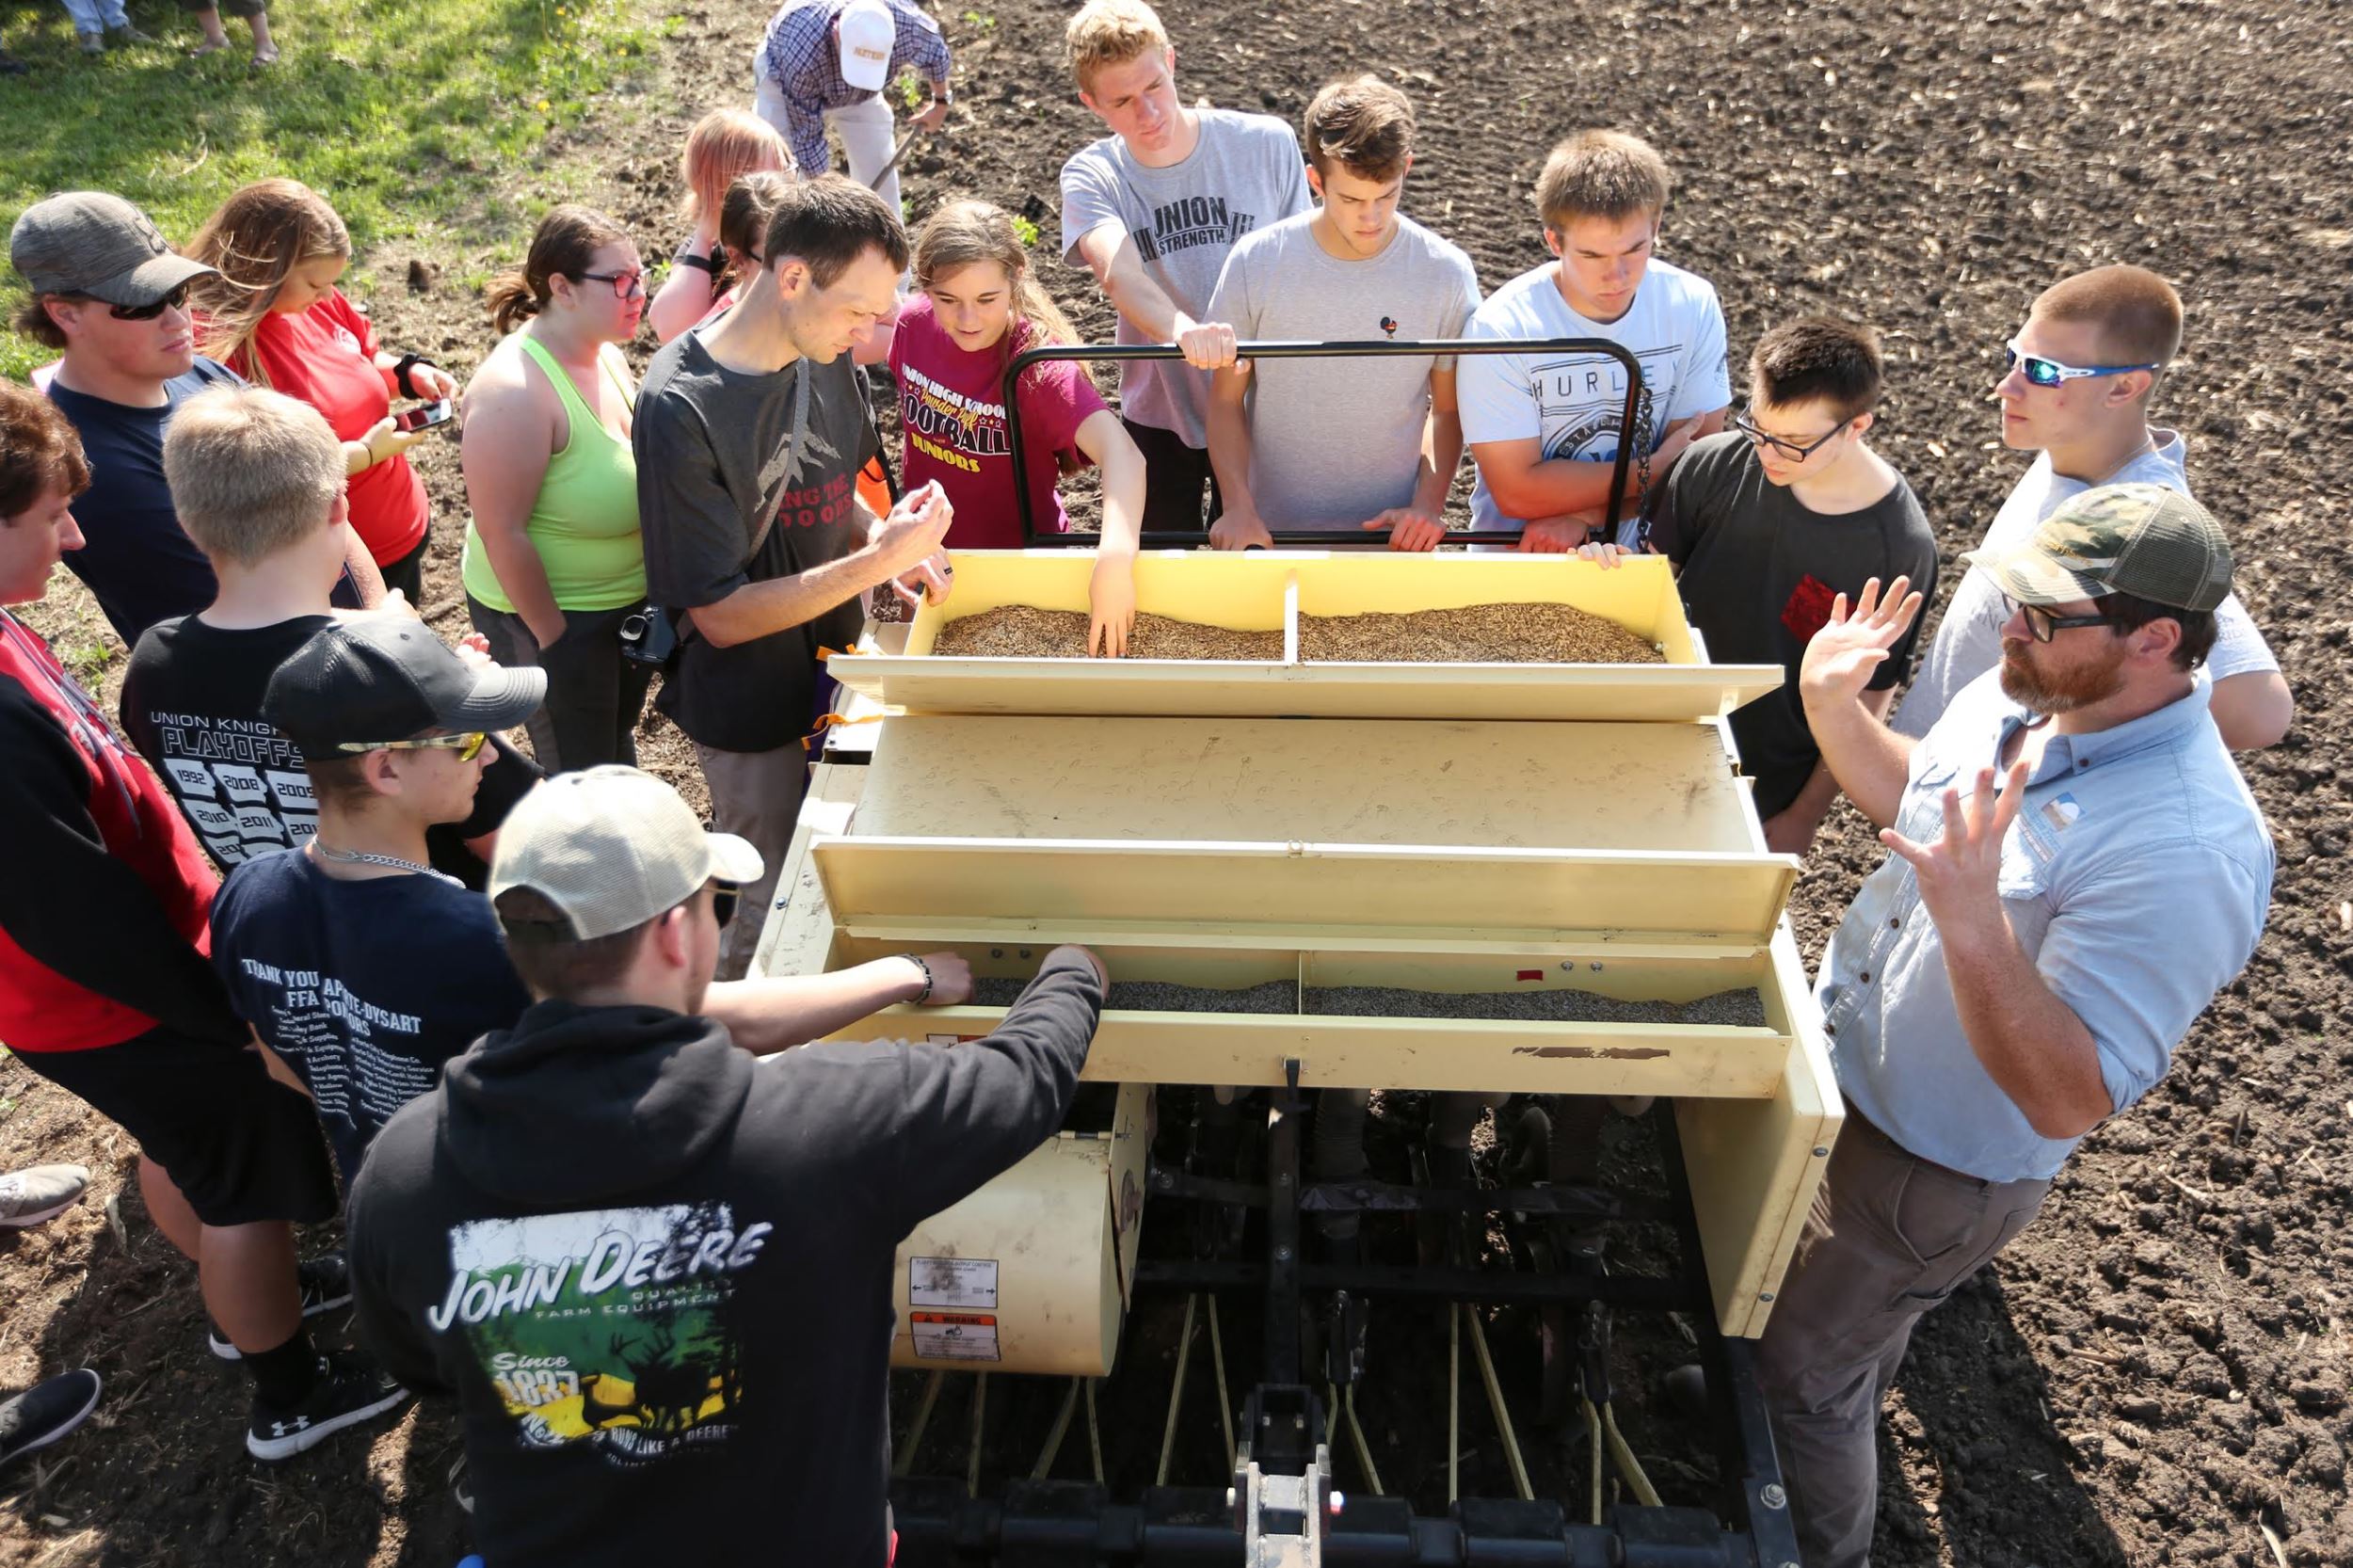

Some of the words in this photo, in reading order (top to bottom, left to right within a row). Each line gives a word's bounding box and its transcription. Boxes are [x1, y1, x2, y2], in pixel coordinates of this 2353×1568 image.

[1158, 229, 1225, 256] STRENGTH
[929, 380, 964, 408] HIGH
[1532, 361, 1679, 402] HURLE
[904, 393, 1011, 456] OOTBALL
[151, 711, 211, 728] UNION
[162, 727, 306, 769] PLAYOFFS
[177, 769, 207, 785] 1992
[223, 775, 260, 791] 2008
[196, 809, 230, 824] 2010
[240, 816, 274, 829] 2011
[284, 970, 321, 988] YOU
[286, 990, 321, 1008] FFA
[429, 1255, 571, 1332] JOHN
[580, 1222, 774, 1293] DEERE
[535, 1307, 592, 1319] FARM
[602, 1288, 736, 1314] EQUIPMENT
[492, 1352, 571, 1370] Since
[495, 1369, 580, 1406] 1837
[636, 1438, 665, 1455] LIKE
